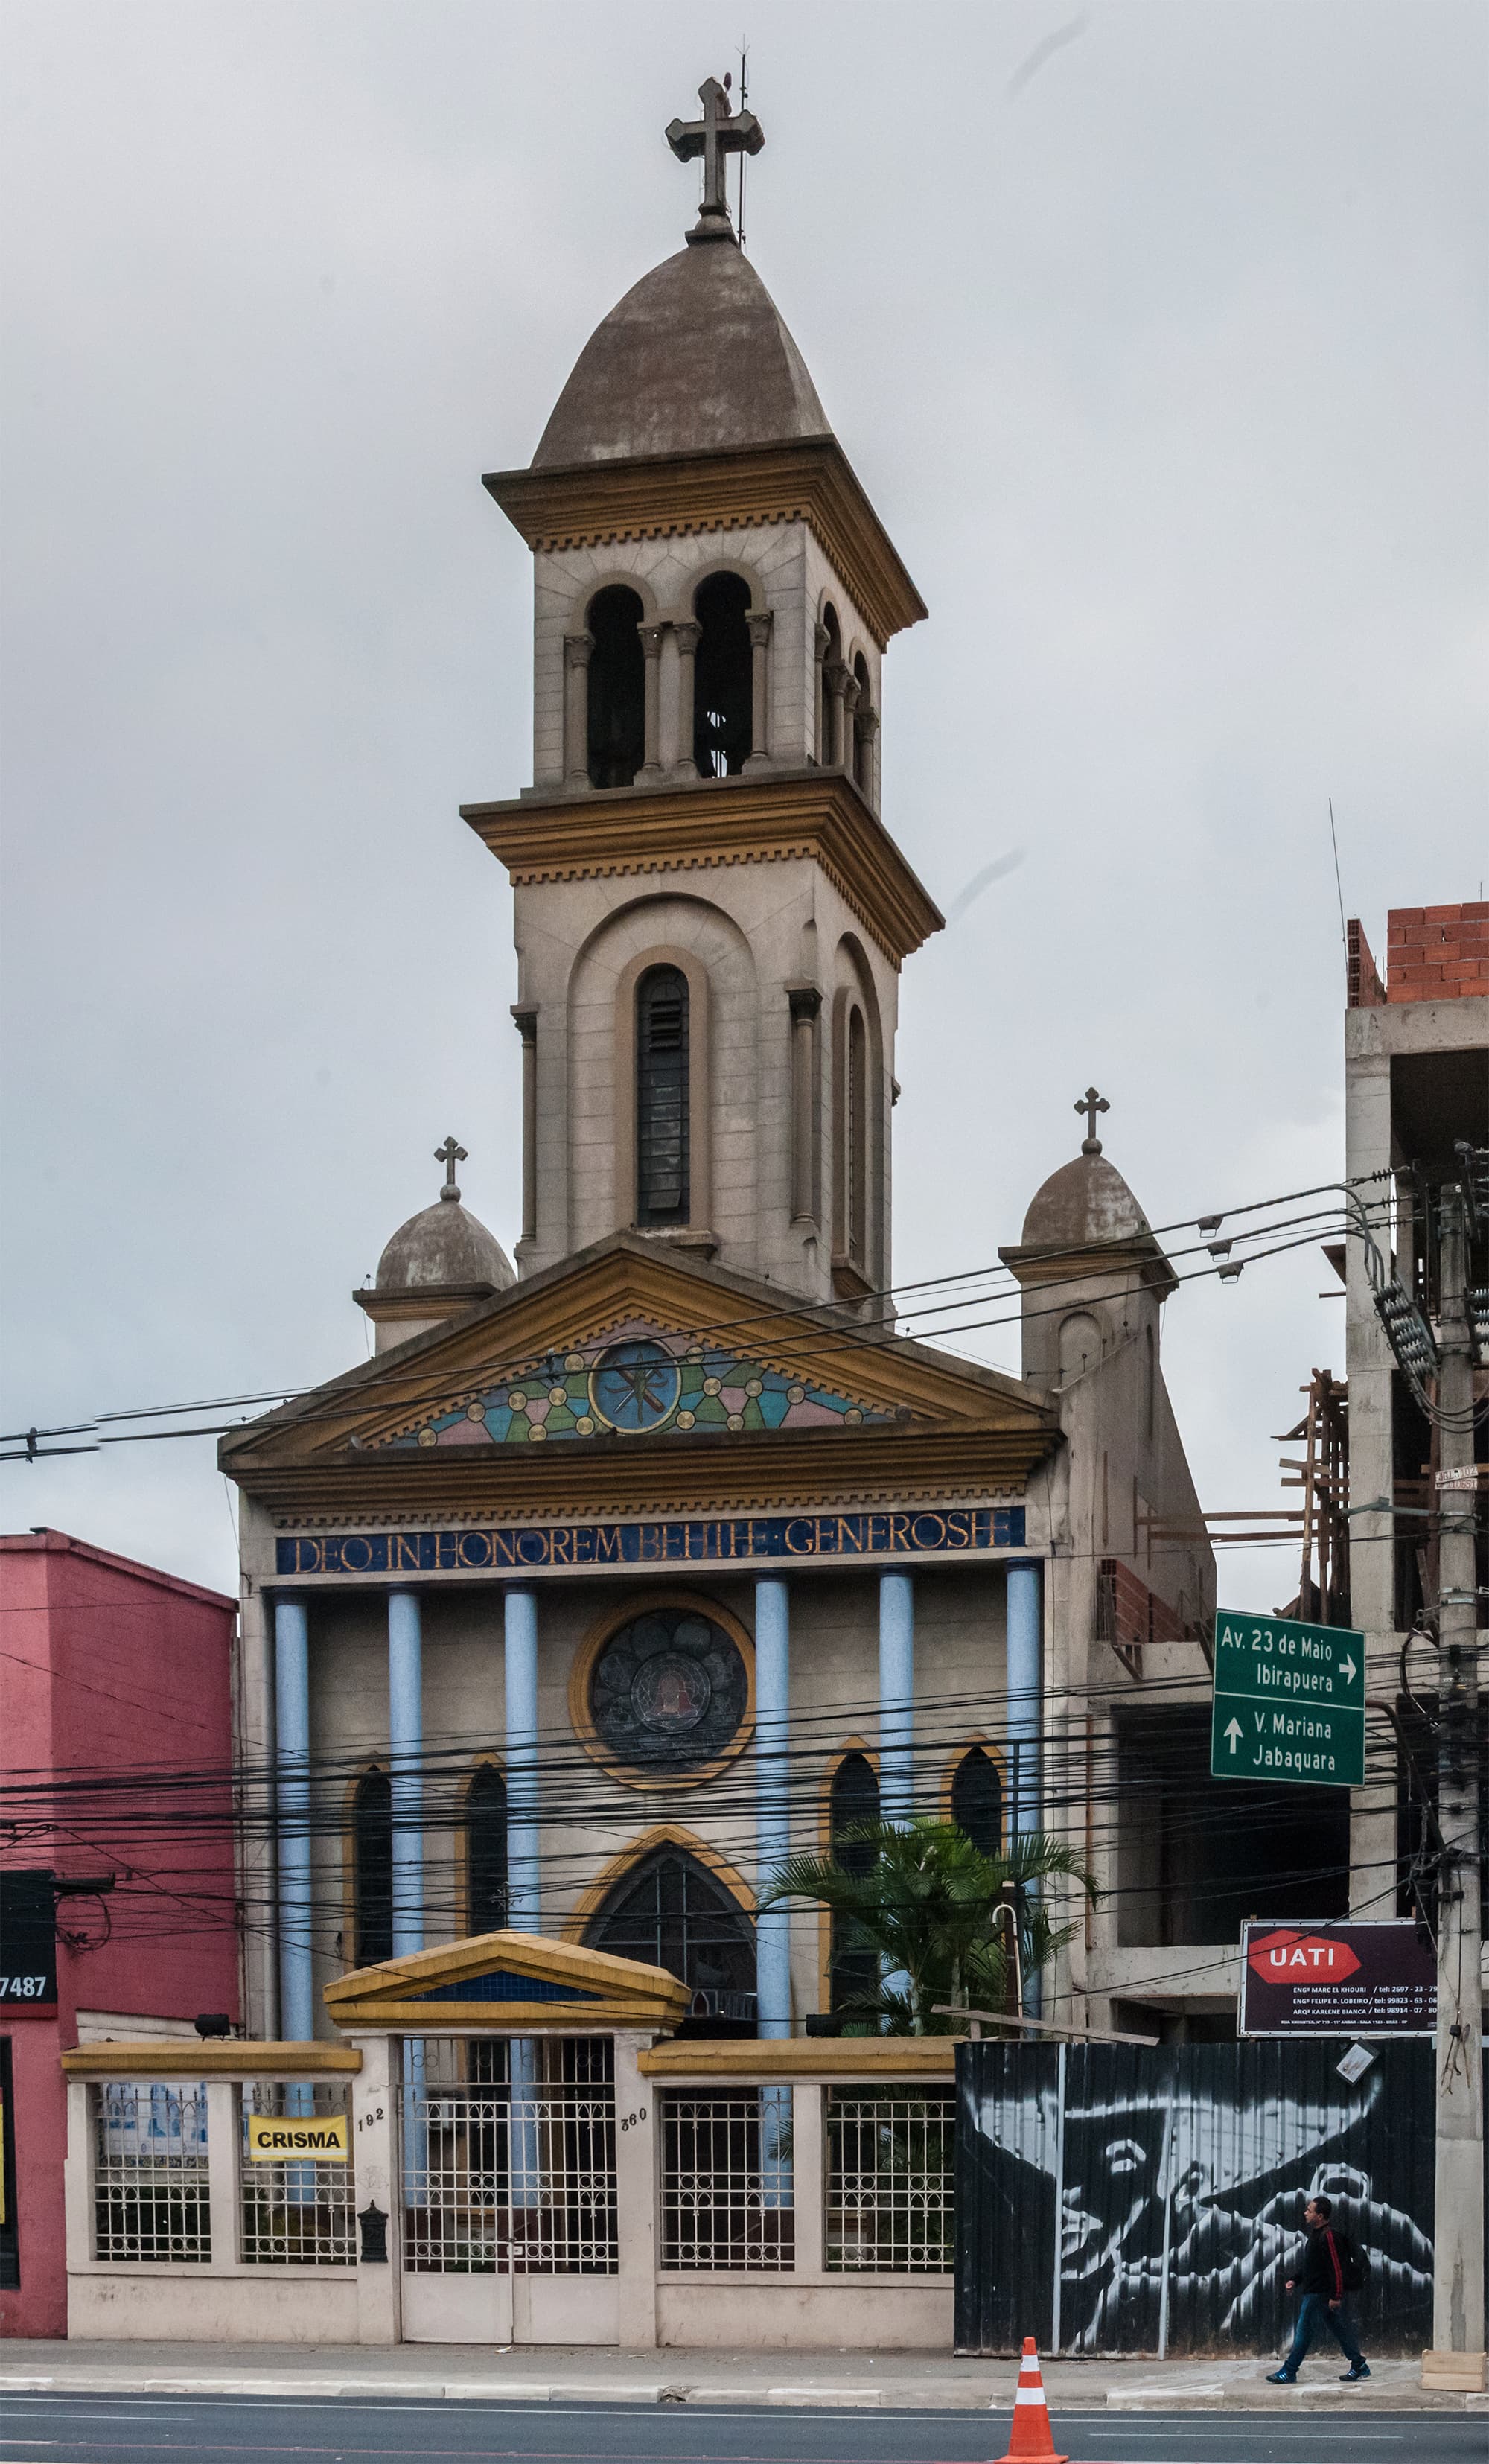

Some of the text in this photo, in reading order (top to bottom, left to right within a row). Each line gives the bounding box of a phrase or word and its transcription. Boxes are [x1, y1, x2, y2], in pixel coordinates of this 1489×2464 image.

[293, 1537, 372, 1573] DEO
[385, 1534, 421, 1570] IN
[433, 1526, 625, 1570] HONOREM
[1221, 1626, 1332, 1661] Av. 23 de Maio
[1257, 1664, 1333, 1693] Ibirapuera
[1254, 1712, 1332, 1739] V. Mariana
[1253, 1745, 1335, 1772] Jabaquara
[1270, 1948, 1334, 1967] UATI
[0, 1976, 46, 1996] 7487
[357, 2108, 384, 2131] 192
[621, 2107, 647, 2132] 360
[257, 2131, 340, 2148] CRISMA
